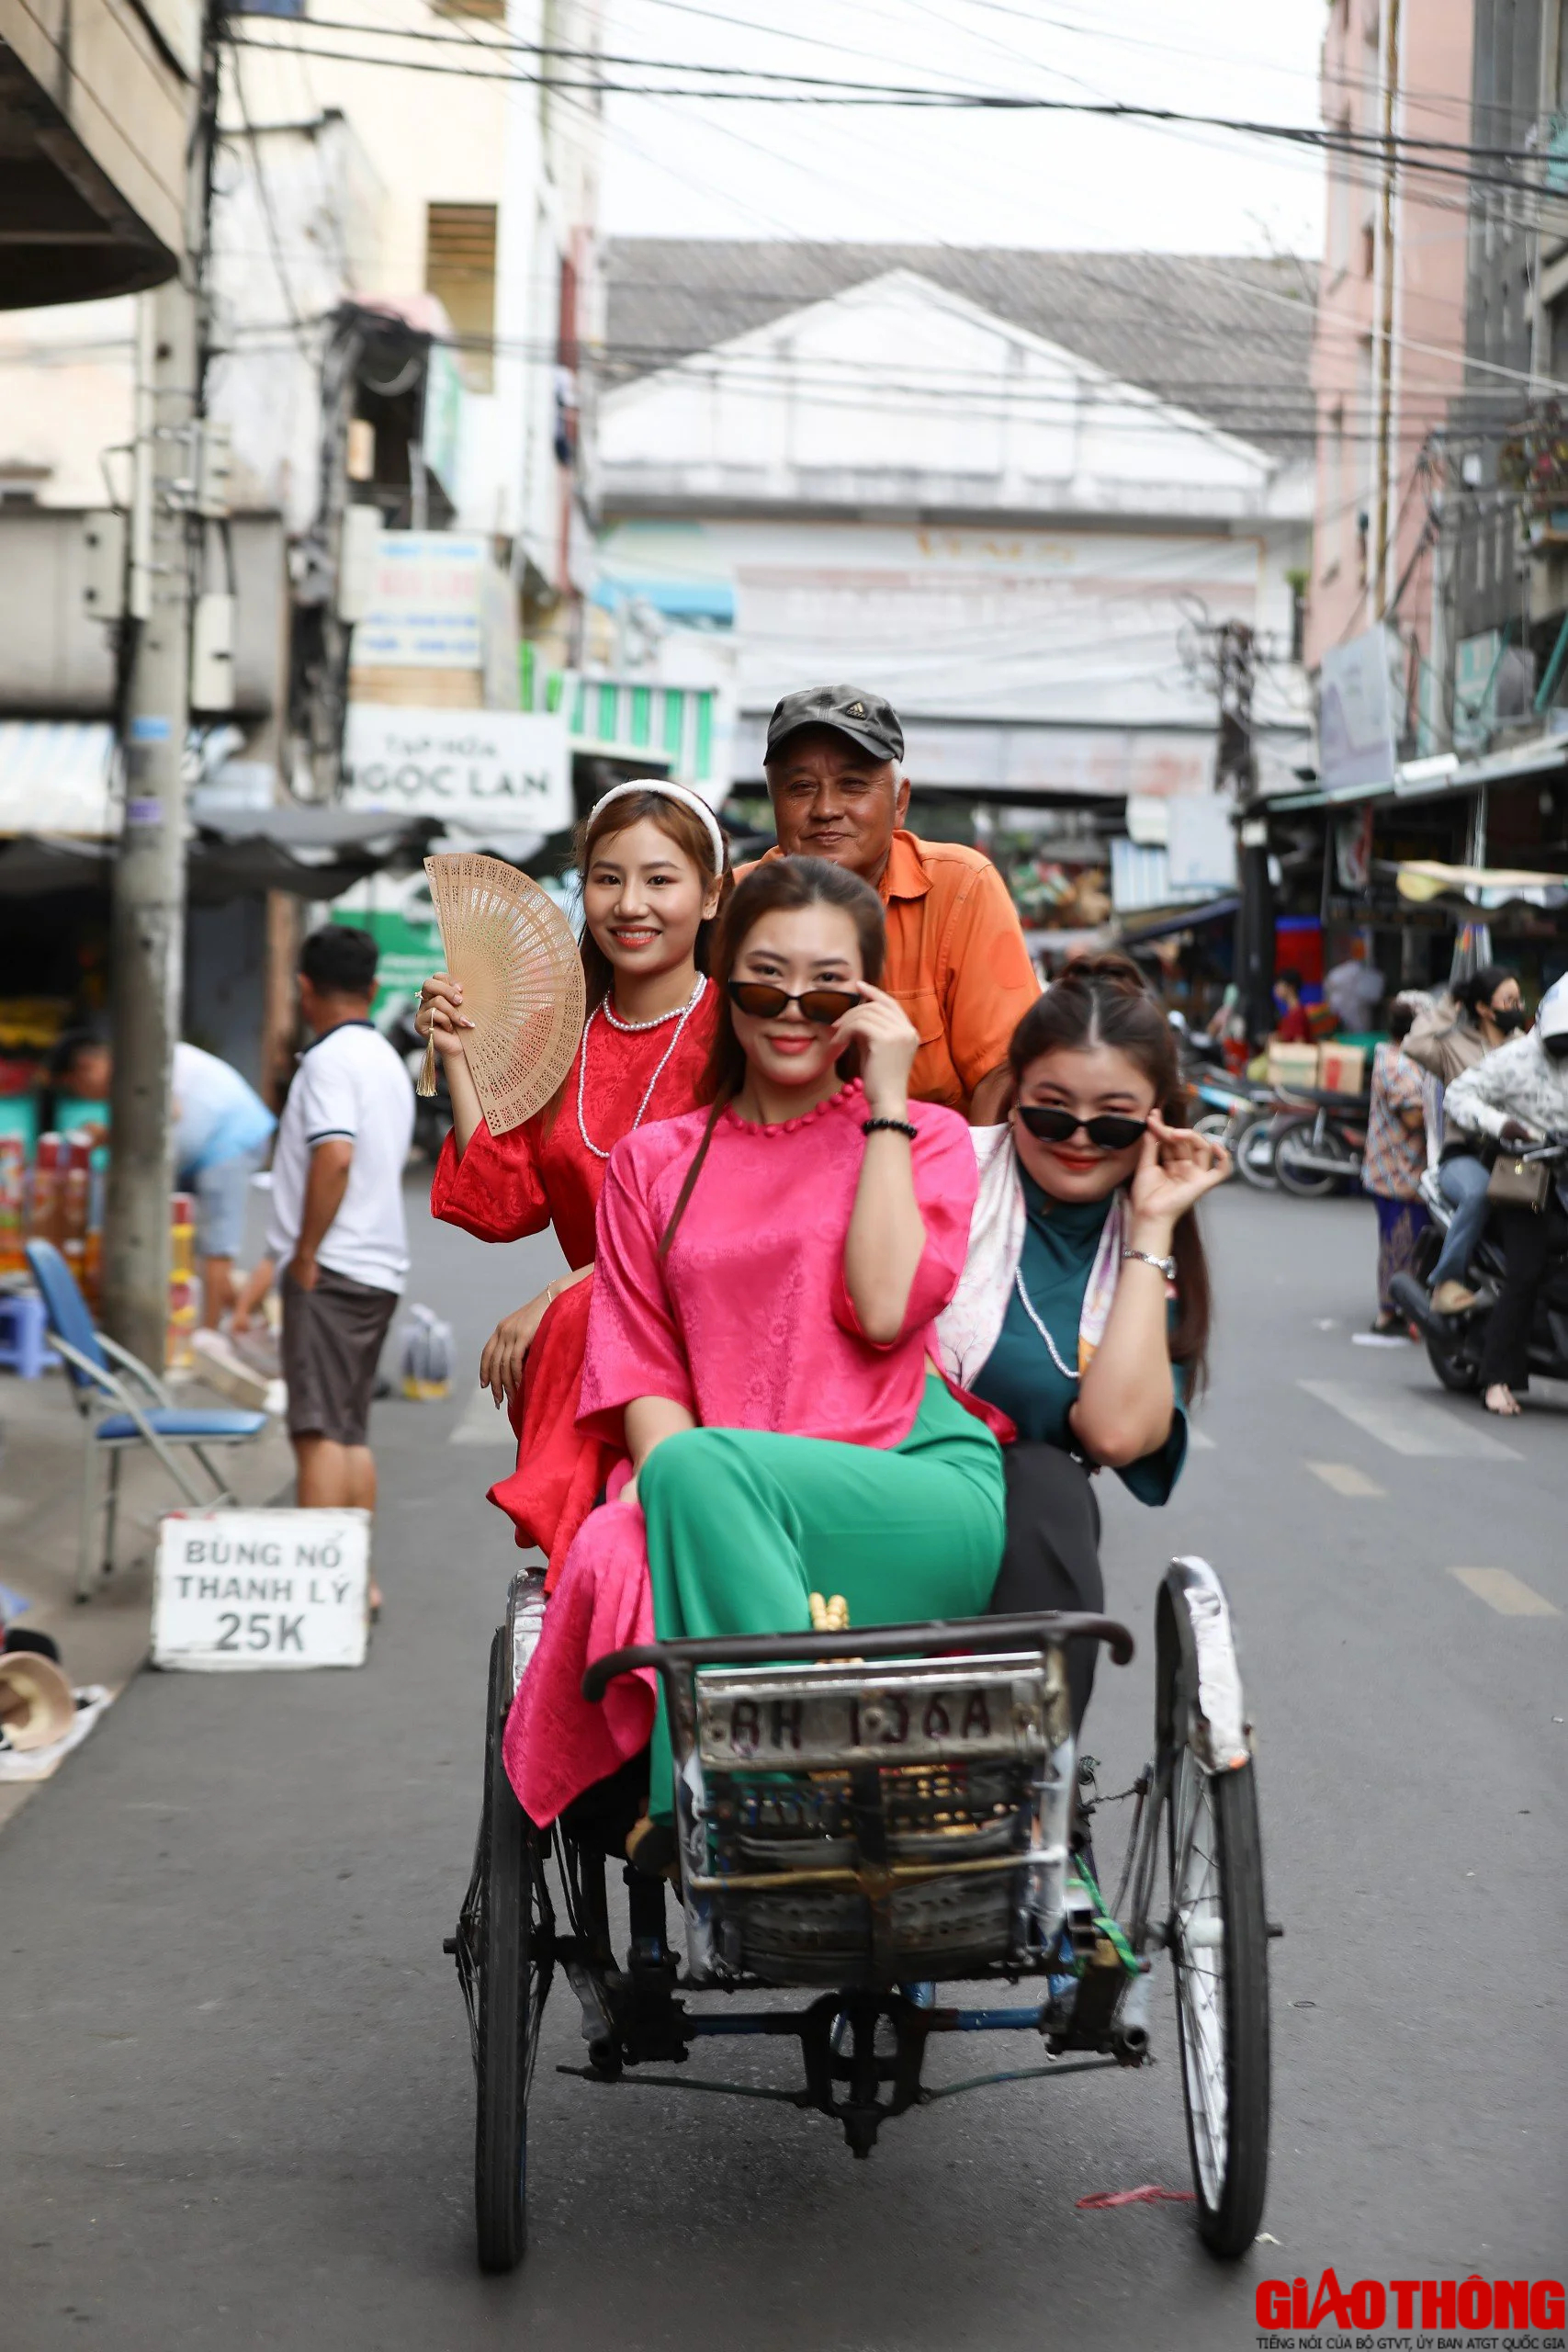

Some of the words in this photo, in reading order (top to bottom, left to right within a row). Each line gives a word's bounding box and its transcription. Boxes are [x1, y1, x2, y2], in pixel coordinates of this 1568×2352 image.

[468, 768, 549, 798] LAN
[175, 1575, 294, 1601] THANH
[215, 1612, 307, 1653] 25K
